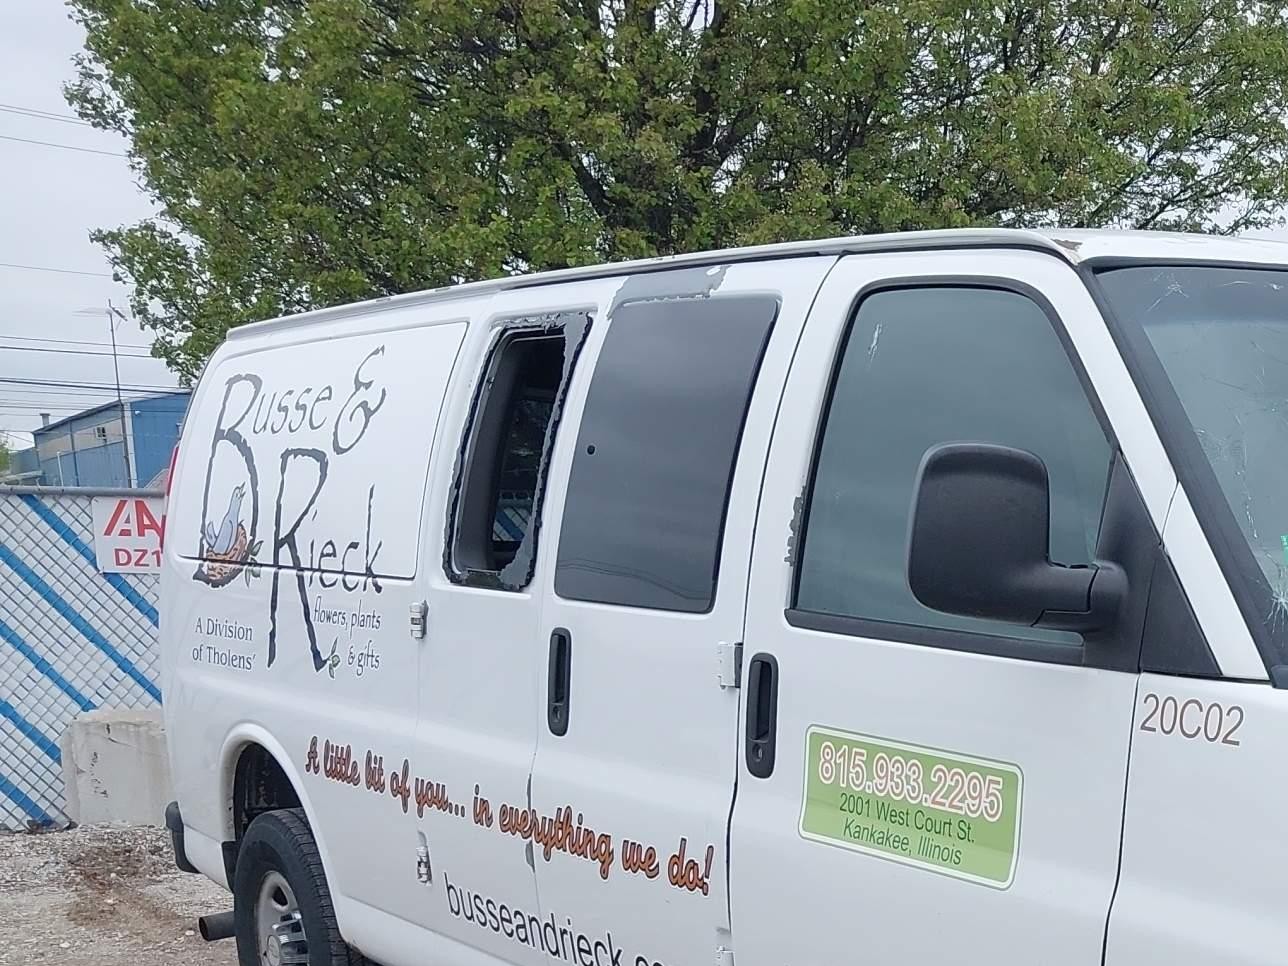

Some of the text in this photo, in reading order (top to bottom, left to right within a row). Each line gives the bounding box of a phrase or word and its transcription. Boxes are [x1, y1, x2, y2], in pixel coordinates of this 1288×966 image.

[192, 344, 387, 588] Busse &
[267, 447, 384, 673] Rieck
[194, 617, 253, 642] A Division
[313, 596, 382, 639] flowers, plants
[192, 645, 204, 662] of
[347, 638, 381, 676] & gifts
[1139, 692, 1245, 747] 20C02
[817, 741, 1004, 824] 815.933.2295
[304, 735, 715, 897] A little bit of you... in everything we do!
[838, 792, 976, 844] 2001 West Court St.
[842, 816, 963, 867] Kankakee, Illinois
